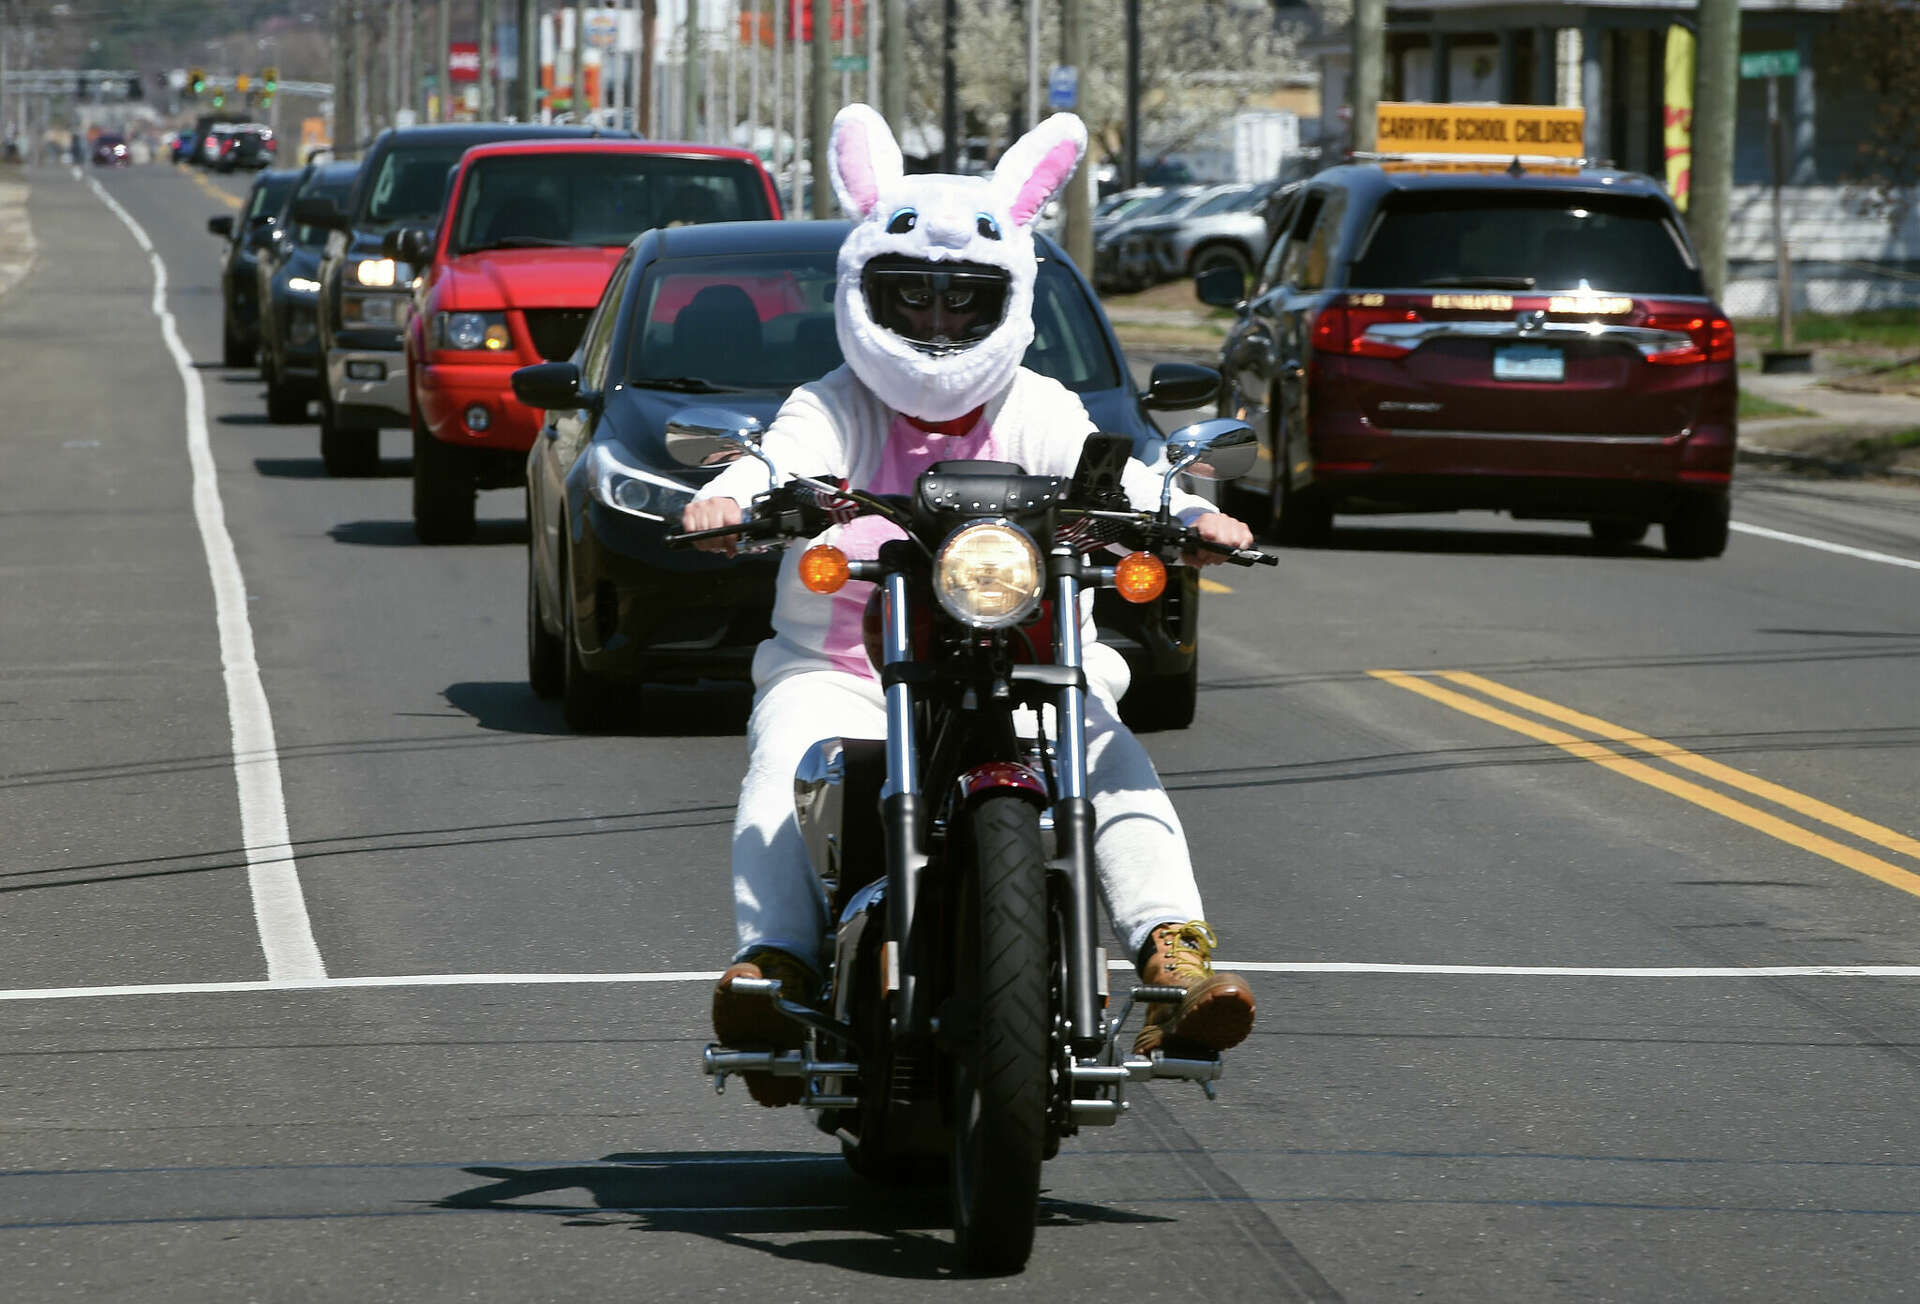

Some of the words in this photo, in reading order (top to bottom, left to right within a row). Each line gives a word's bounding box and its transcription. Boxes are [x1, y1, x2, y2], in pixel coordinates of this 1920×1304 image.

[1378, 115, 1449, 141] CARRYING
[1455, 117, 1509, 142] SCHOOL
[1515, 119, 1583, 144] CHILDREN
